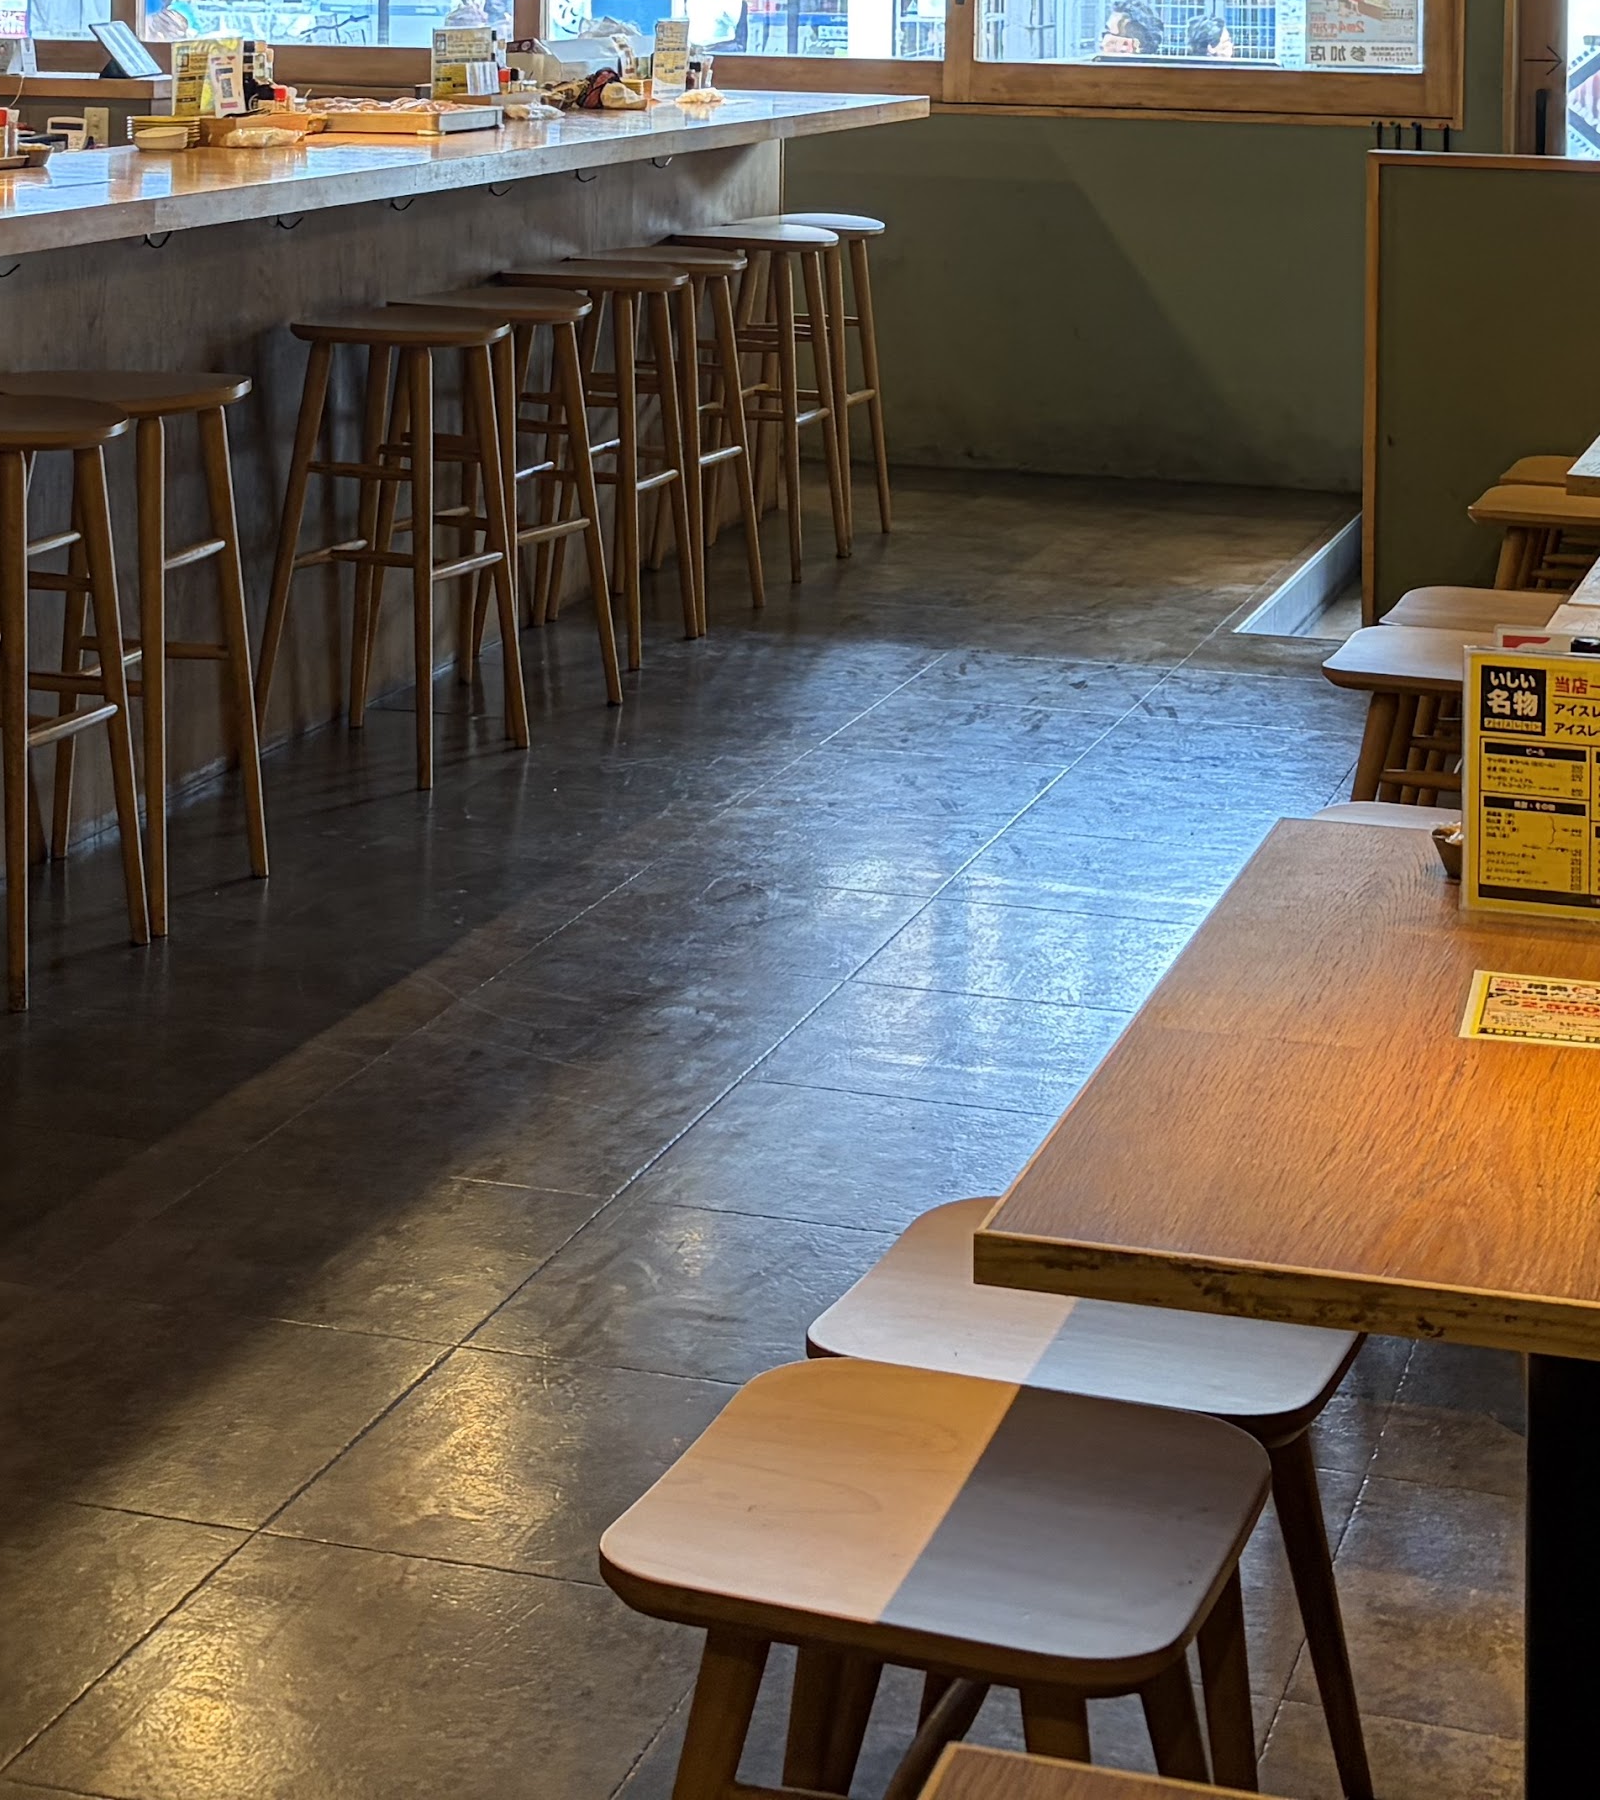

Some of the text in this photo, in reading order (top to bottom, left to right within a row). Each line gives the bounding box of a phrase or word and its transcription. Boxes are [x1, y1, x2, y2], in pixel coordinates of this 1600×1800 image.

[1490, 671, 1536, 688] いしい
[1486, 689, 1539, 716] 名物
